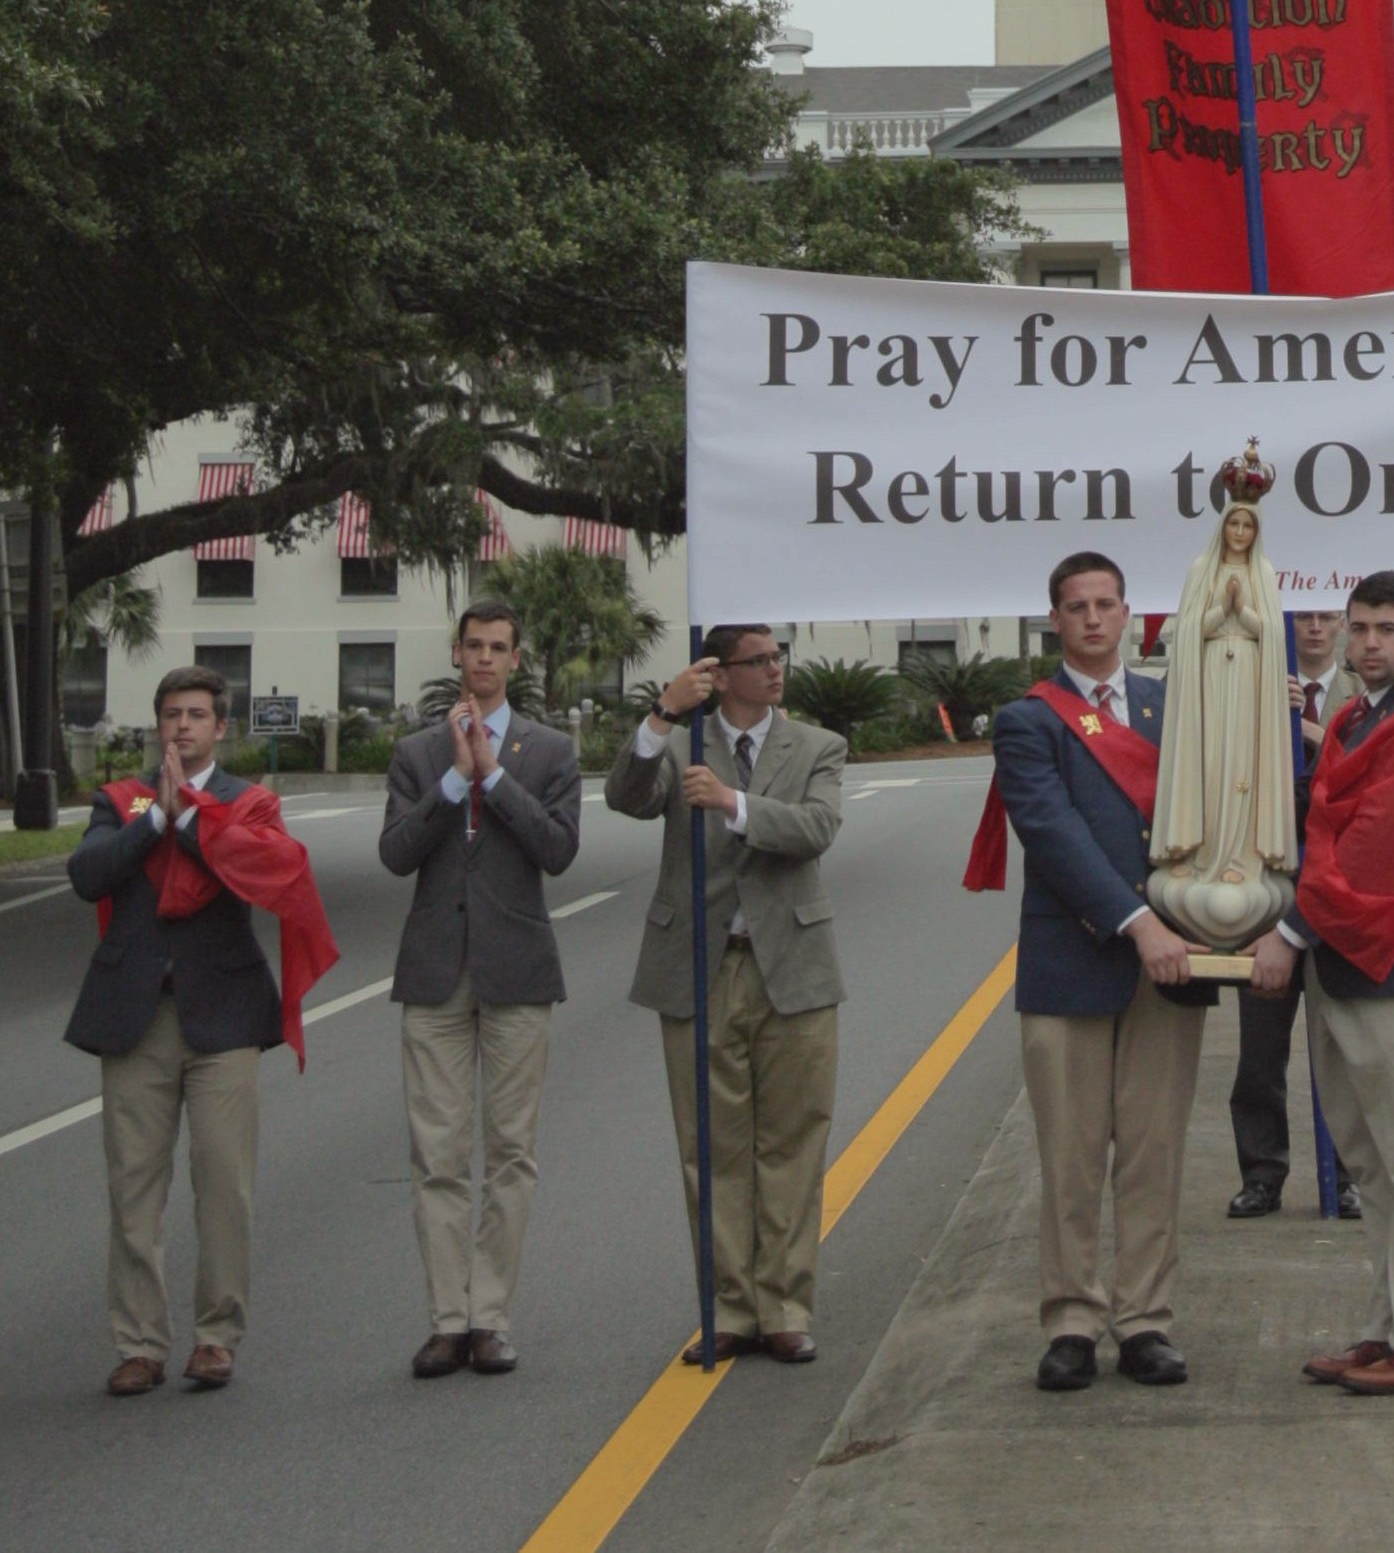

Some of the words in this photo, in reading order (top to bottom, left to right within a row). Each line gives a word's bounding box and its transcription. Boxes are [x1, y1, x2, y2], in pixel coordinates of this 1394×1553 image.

[759, 313, 980, 410] Pray
[1013, 312, 1148, 387] for
[806, 451, 1137, 525] Return
[1276, 570, 1317, 591] The
